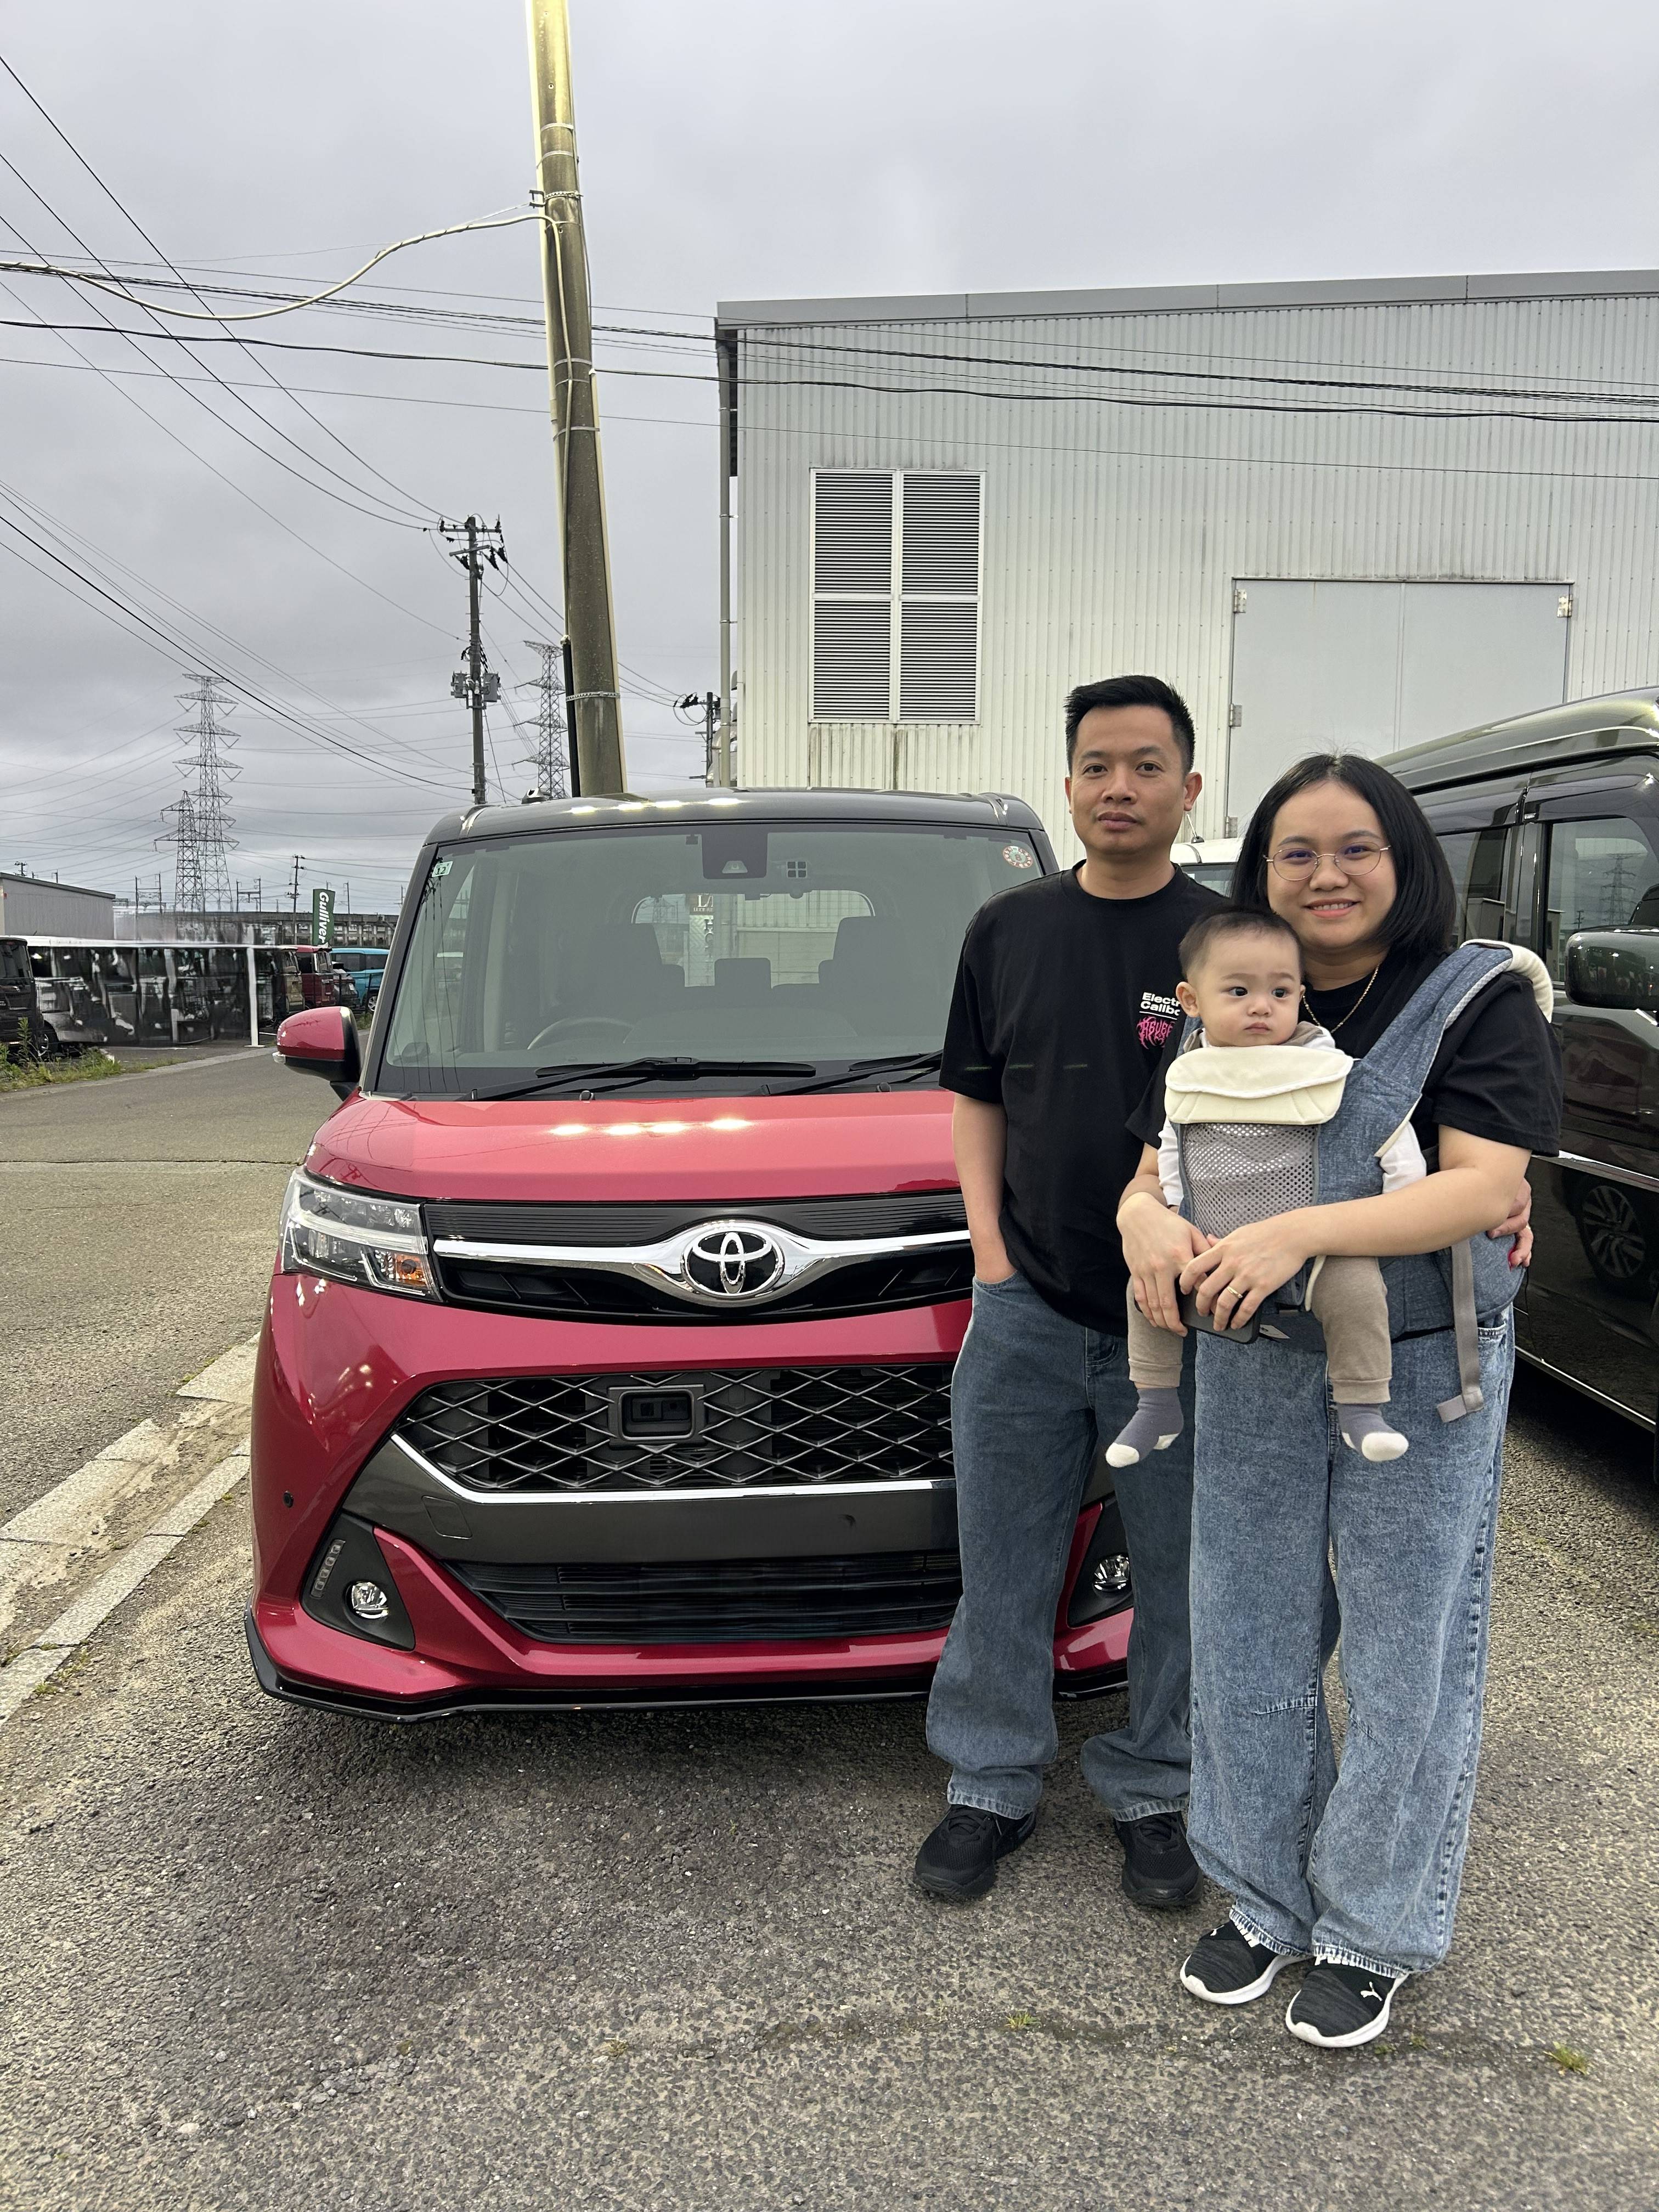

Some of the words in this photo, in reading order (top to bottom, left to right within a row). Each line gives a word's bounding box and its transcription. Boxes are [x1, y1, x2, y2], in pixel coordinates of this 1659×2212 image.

[435, 867, 446, 875] 12
[319, 891, 330, 944] Gulliver
[1142, 992, 1180, 1007] Electr
